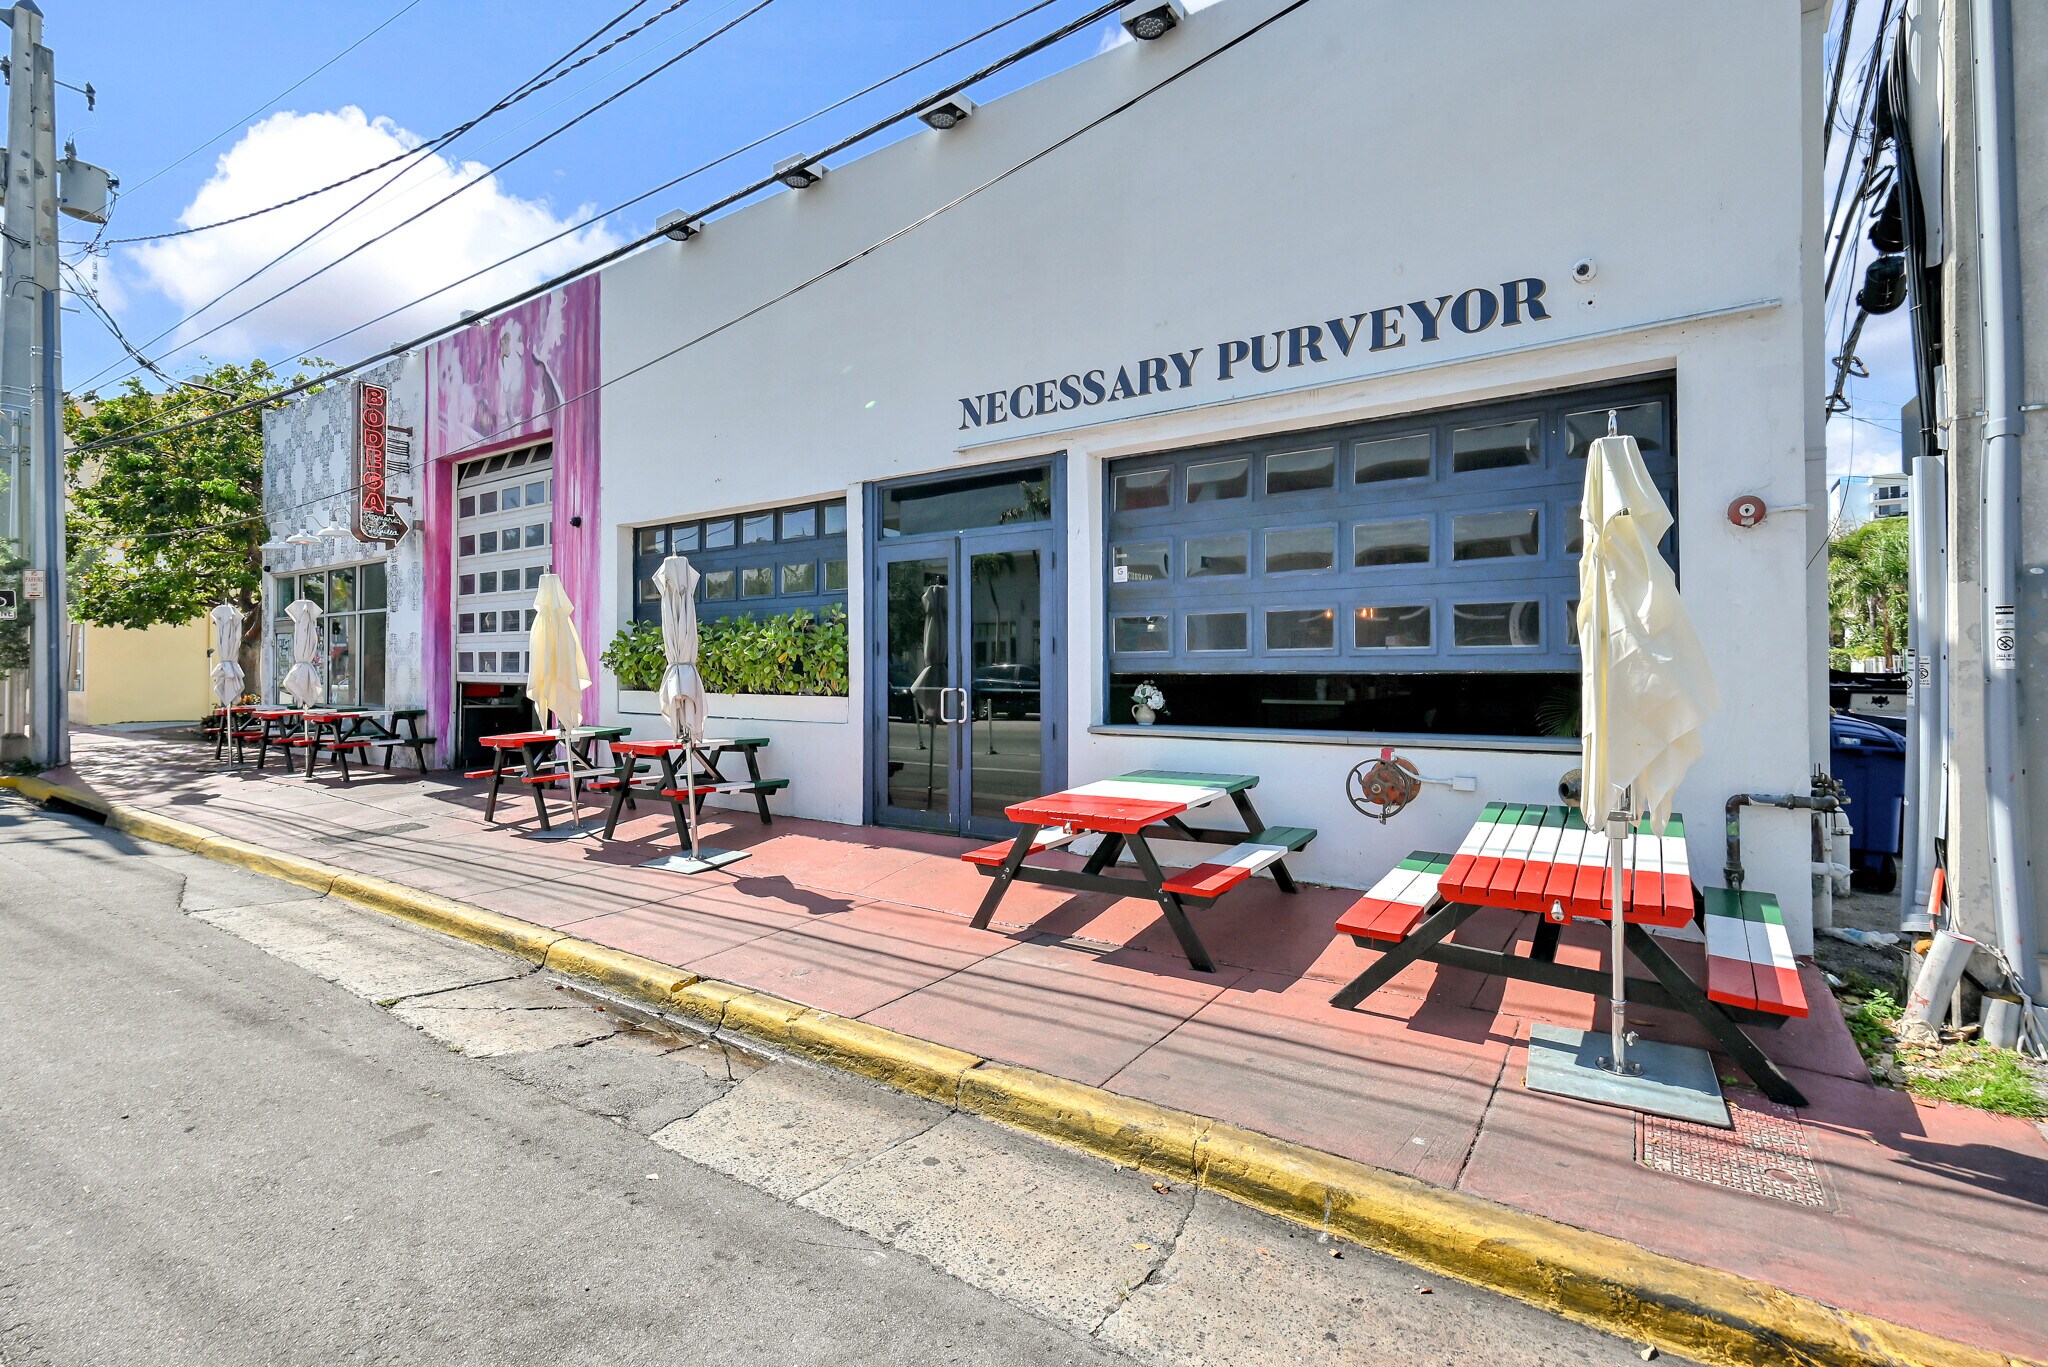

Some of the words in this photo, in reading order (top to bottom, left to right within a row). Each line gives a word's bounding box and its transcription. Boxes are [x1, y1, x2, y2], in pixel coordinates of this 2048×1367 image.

[957, 346, 1204, 431] NECESSARY
[1216, 275, 1553, 382] PURVEYOR
[363, 387, 385, 511] BODEGA
